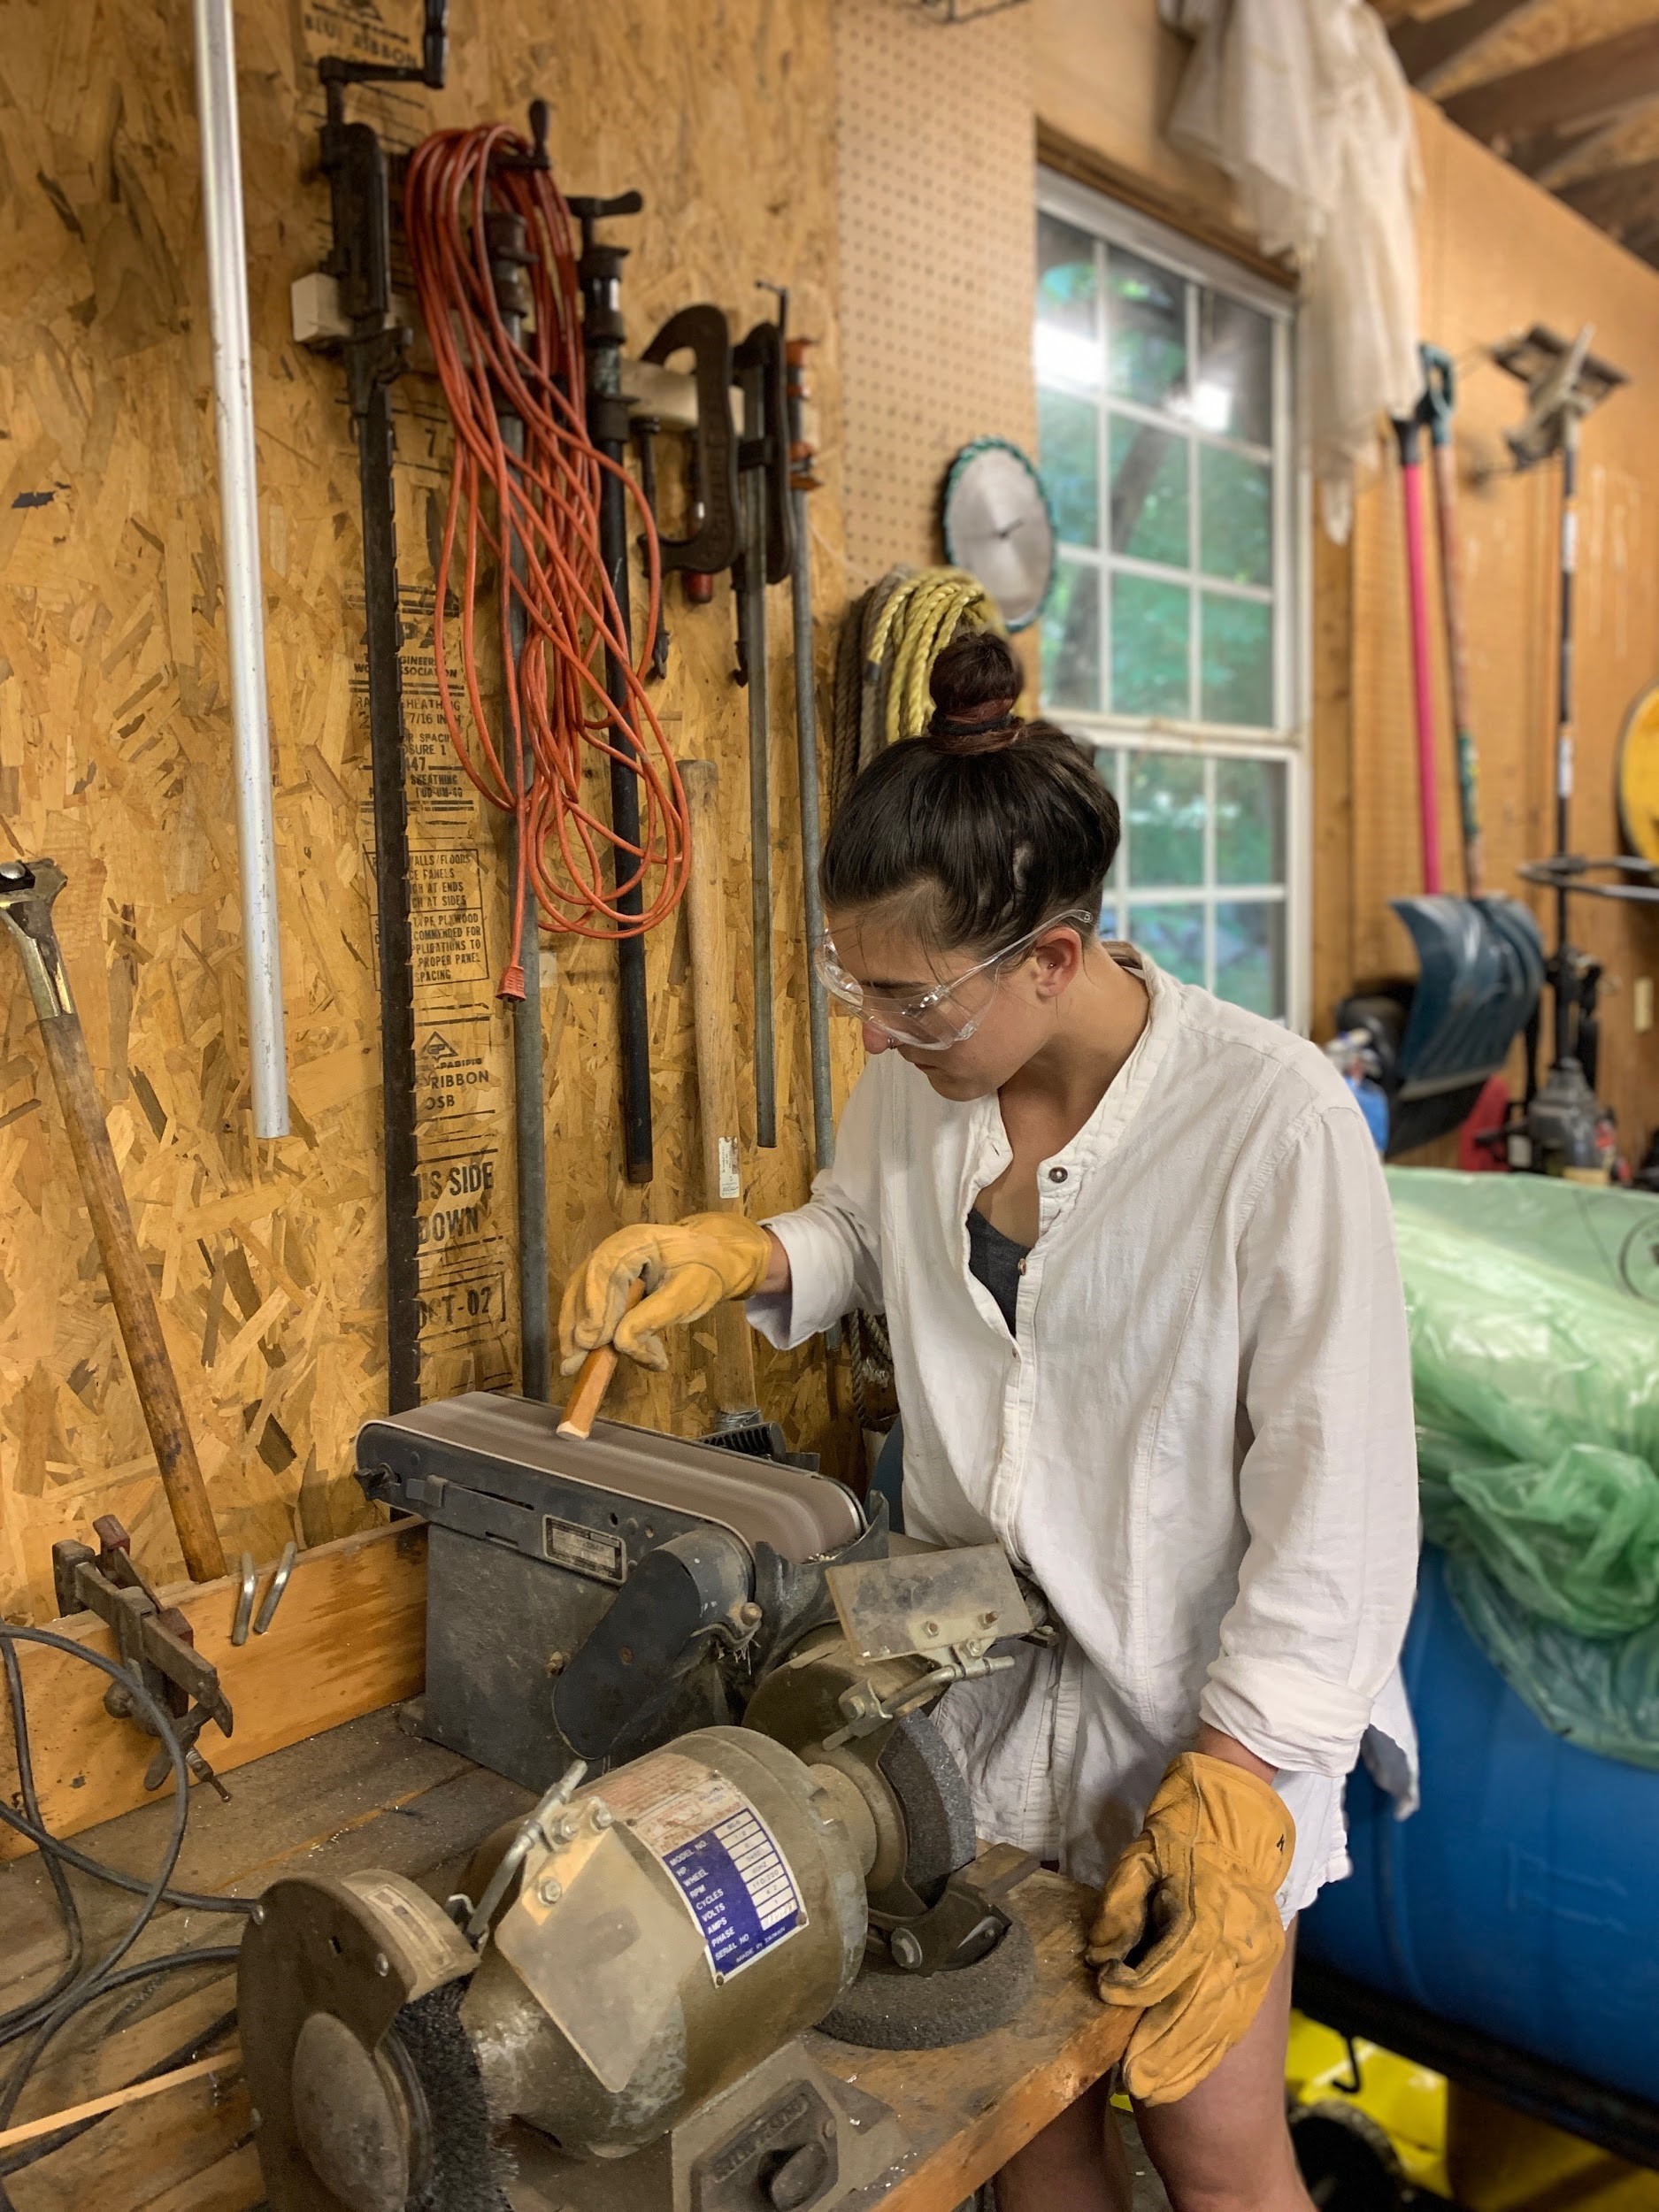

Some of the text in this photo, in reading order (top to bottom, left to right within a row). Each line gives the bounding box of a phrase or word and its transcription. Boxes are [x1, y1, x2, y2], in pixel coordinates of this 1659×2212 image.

[442, 881, 465, 893] ENDS
[442, 894, 466, 906] SIDES
[466, 926, 481, 937] FOR
[470, 938, 481, 950] TO
[431, 1070, 489, 1089] RIBBON
[449, 1161, 495, 1197] SIDE
[695, 1888, 725, 1910] CYCLES
[701, 1902, 726, 1923] VOLTS
[707, 1916, 728, 1935] AMPS
[710, 1926, 736, 1947] PHASE
